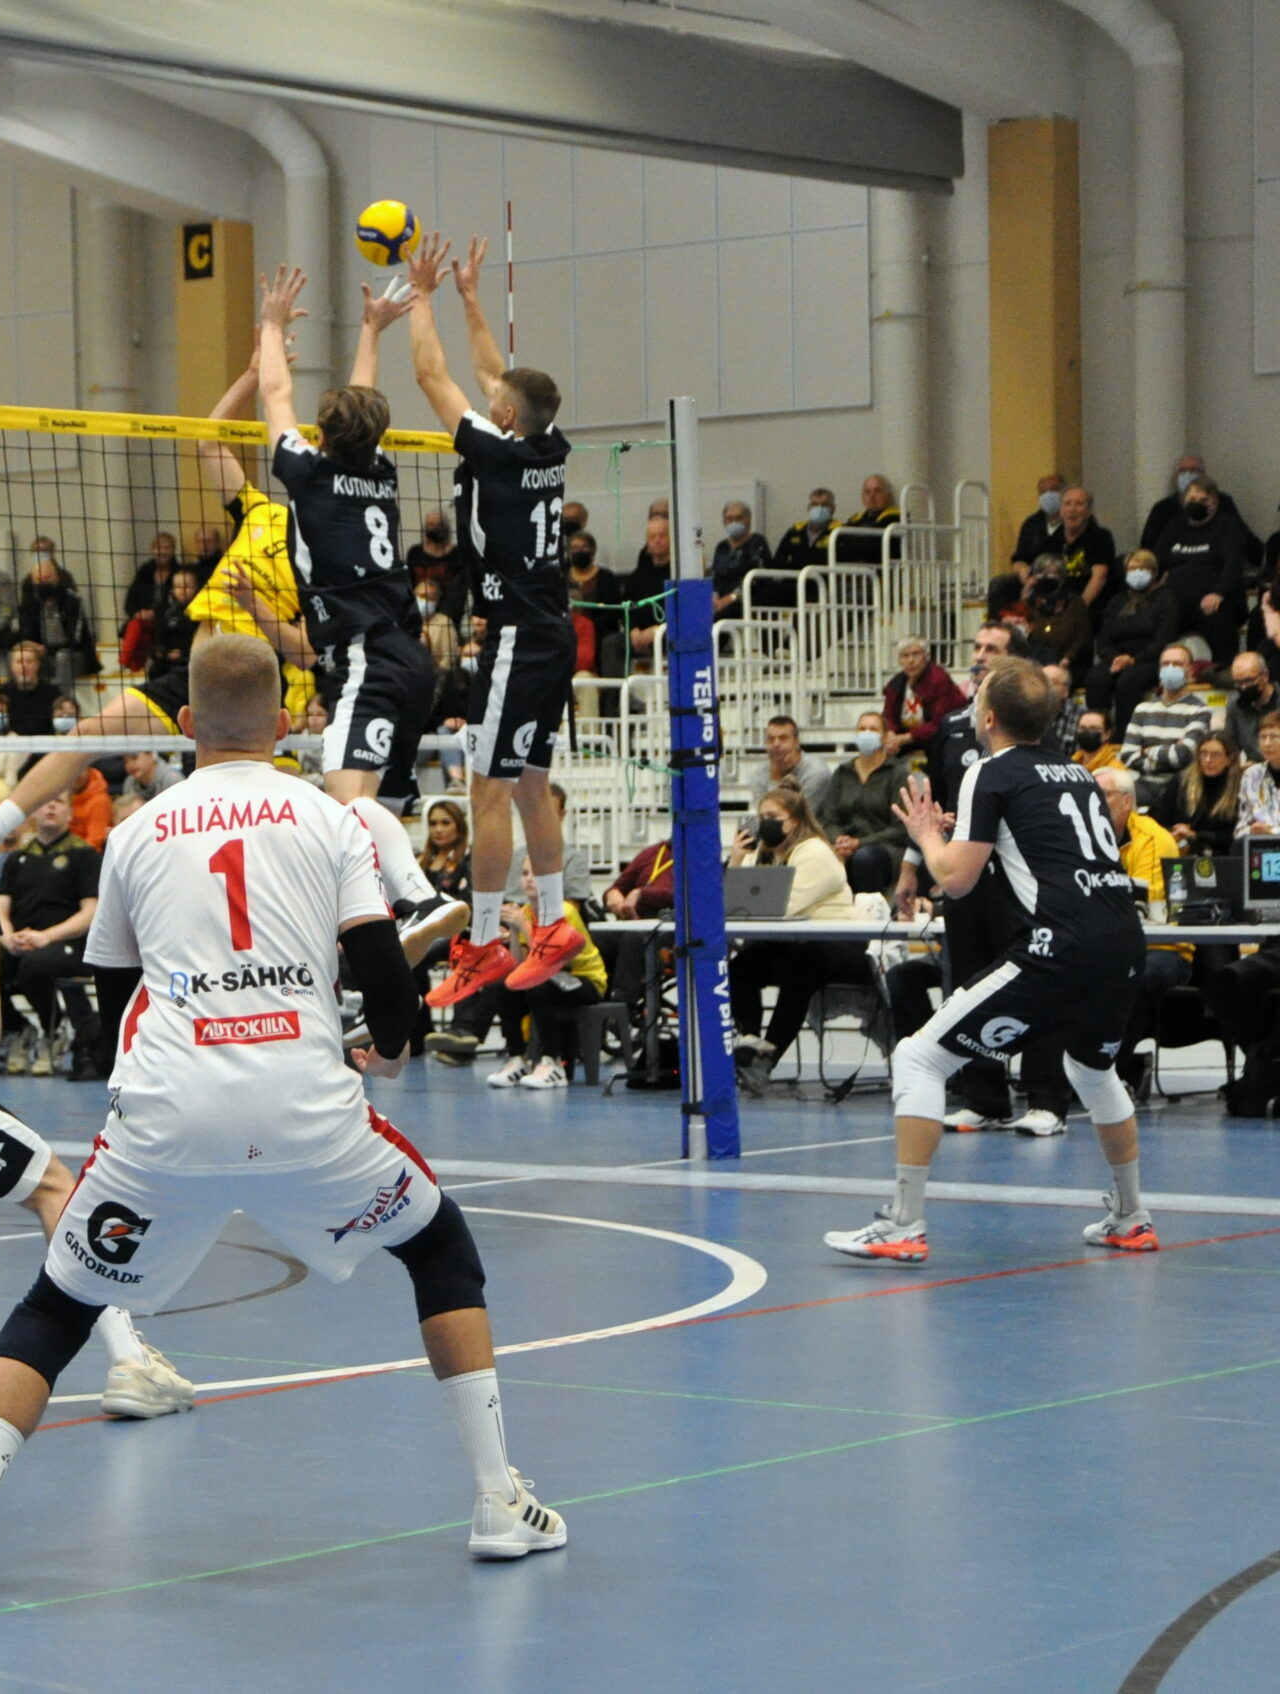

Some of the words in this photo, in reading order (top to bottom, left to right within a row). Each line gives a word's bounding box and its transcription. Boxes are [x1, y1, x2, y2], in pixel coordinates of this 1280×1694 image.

[188, 233, 210, 270] C
[364, 505, 394, 570] 8
[155, 797, 298, 843] SILIÄMAA
[1058, 791, 1120, 862] 16
[208, 838, 253, 951] 1
[191, 962, 315, 994] K-SÄHKÖ
[201, 1015, 296, 1042] AUTOKIILA
[354, 1191, 393, 1230] Well
[65, 1230, 145, 1284] GATORADE
